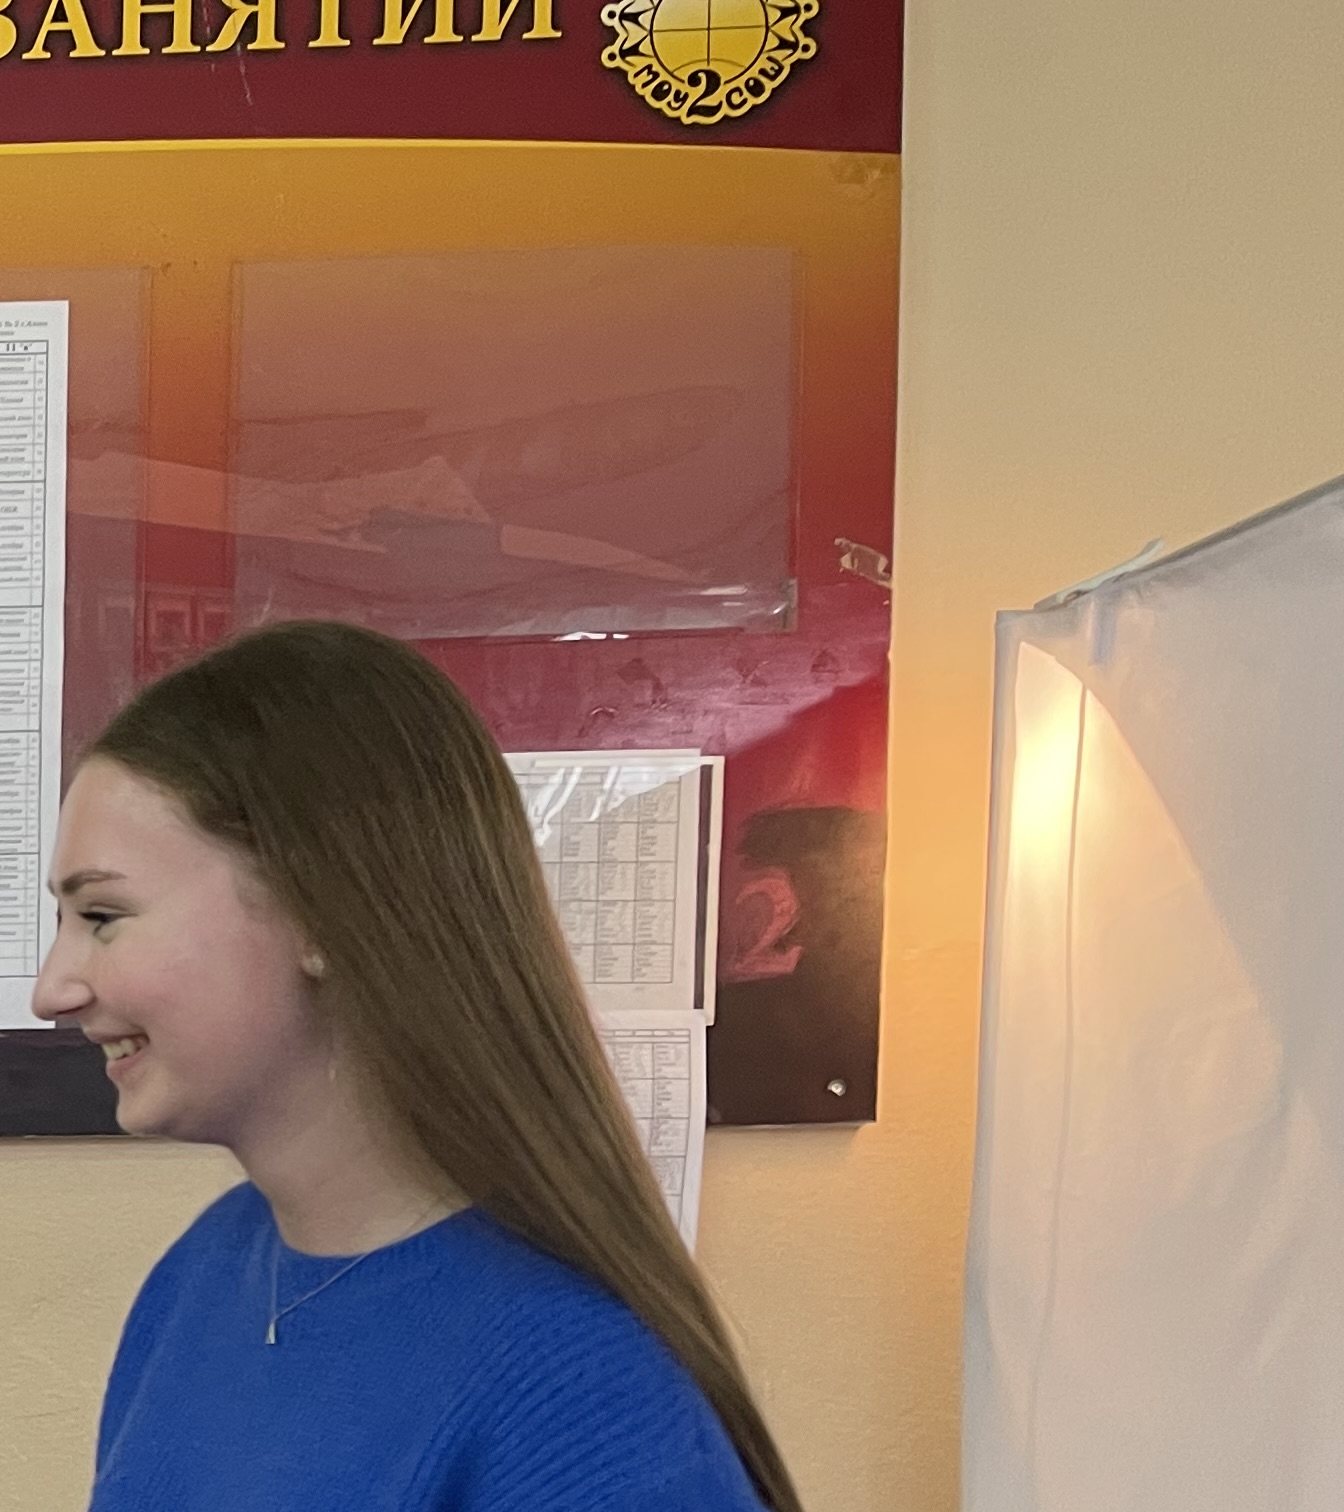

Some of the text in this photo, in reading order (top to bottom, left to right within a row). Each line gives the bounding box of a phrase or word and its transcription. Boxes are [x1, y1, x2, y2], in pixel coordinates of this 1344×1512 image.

[633, 55, 785, 118] МОУ 2 СОШ
